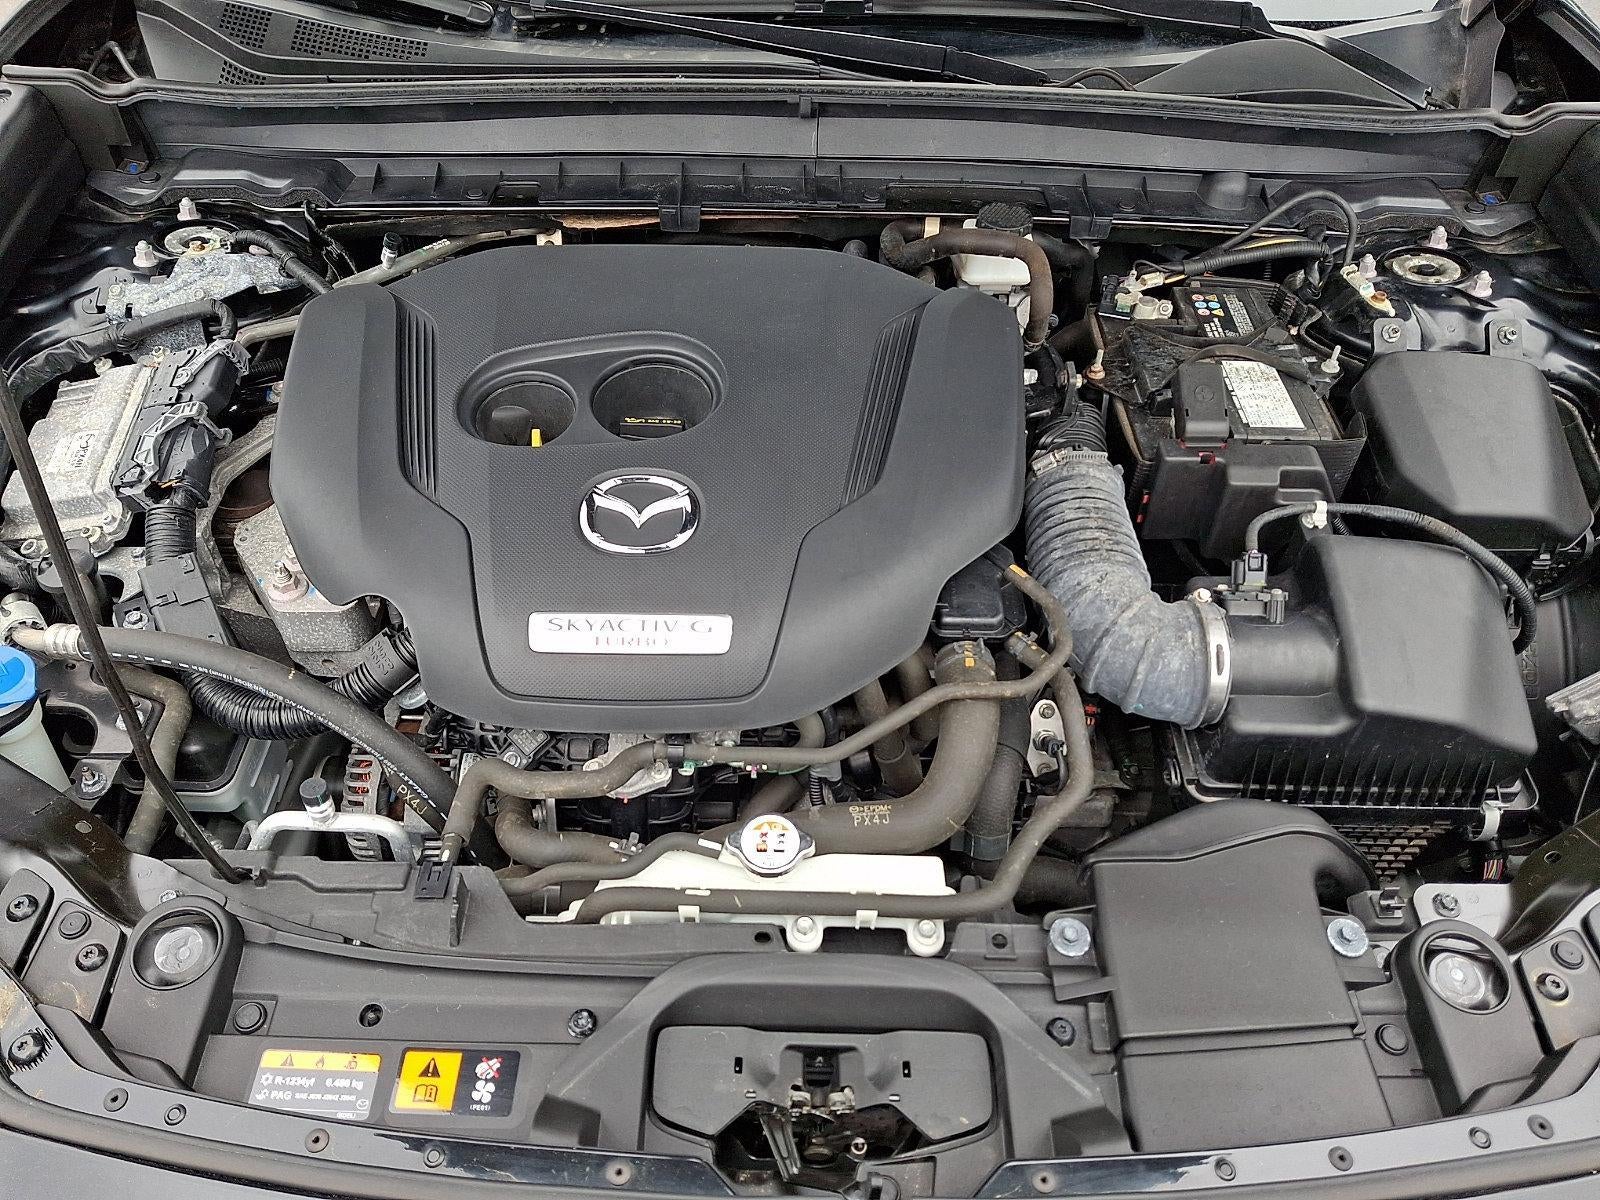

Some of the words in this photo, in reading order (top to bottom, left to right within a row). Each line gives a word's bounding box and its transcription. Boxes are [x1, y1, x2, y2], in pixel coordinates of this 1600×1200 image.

[396, 784, 428, 815] PX4J
[854, 814, 890, 827] PX4J
[274, 1074, 316, 1089] R-1234yf
[270, 1089, 293, 1101] PAG
